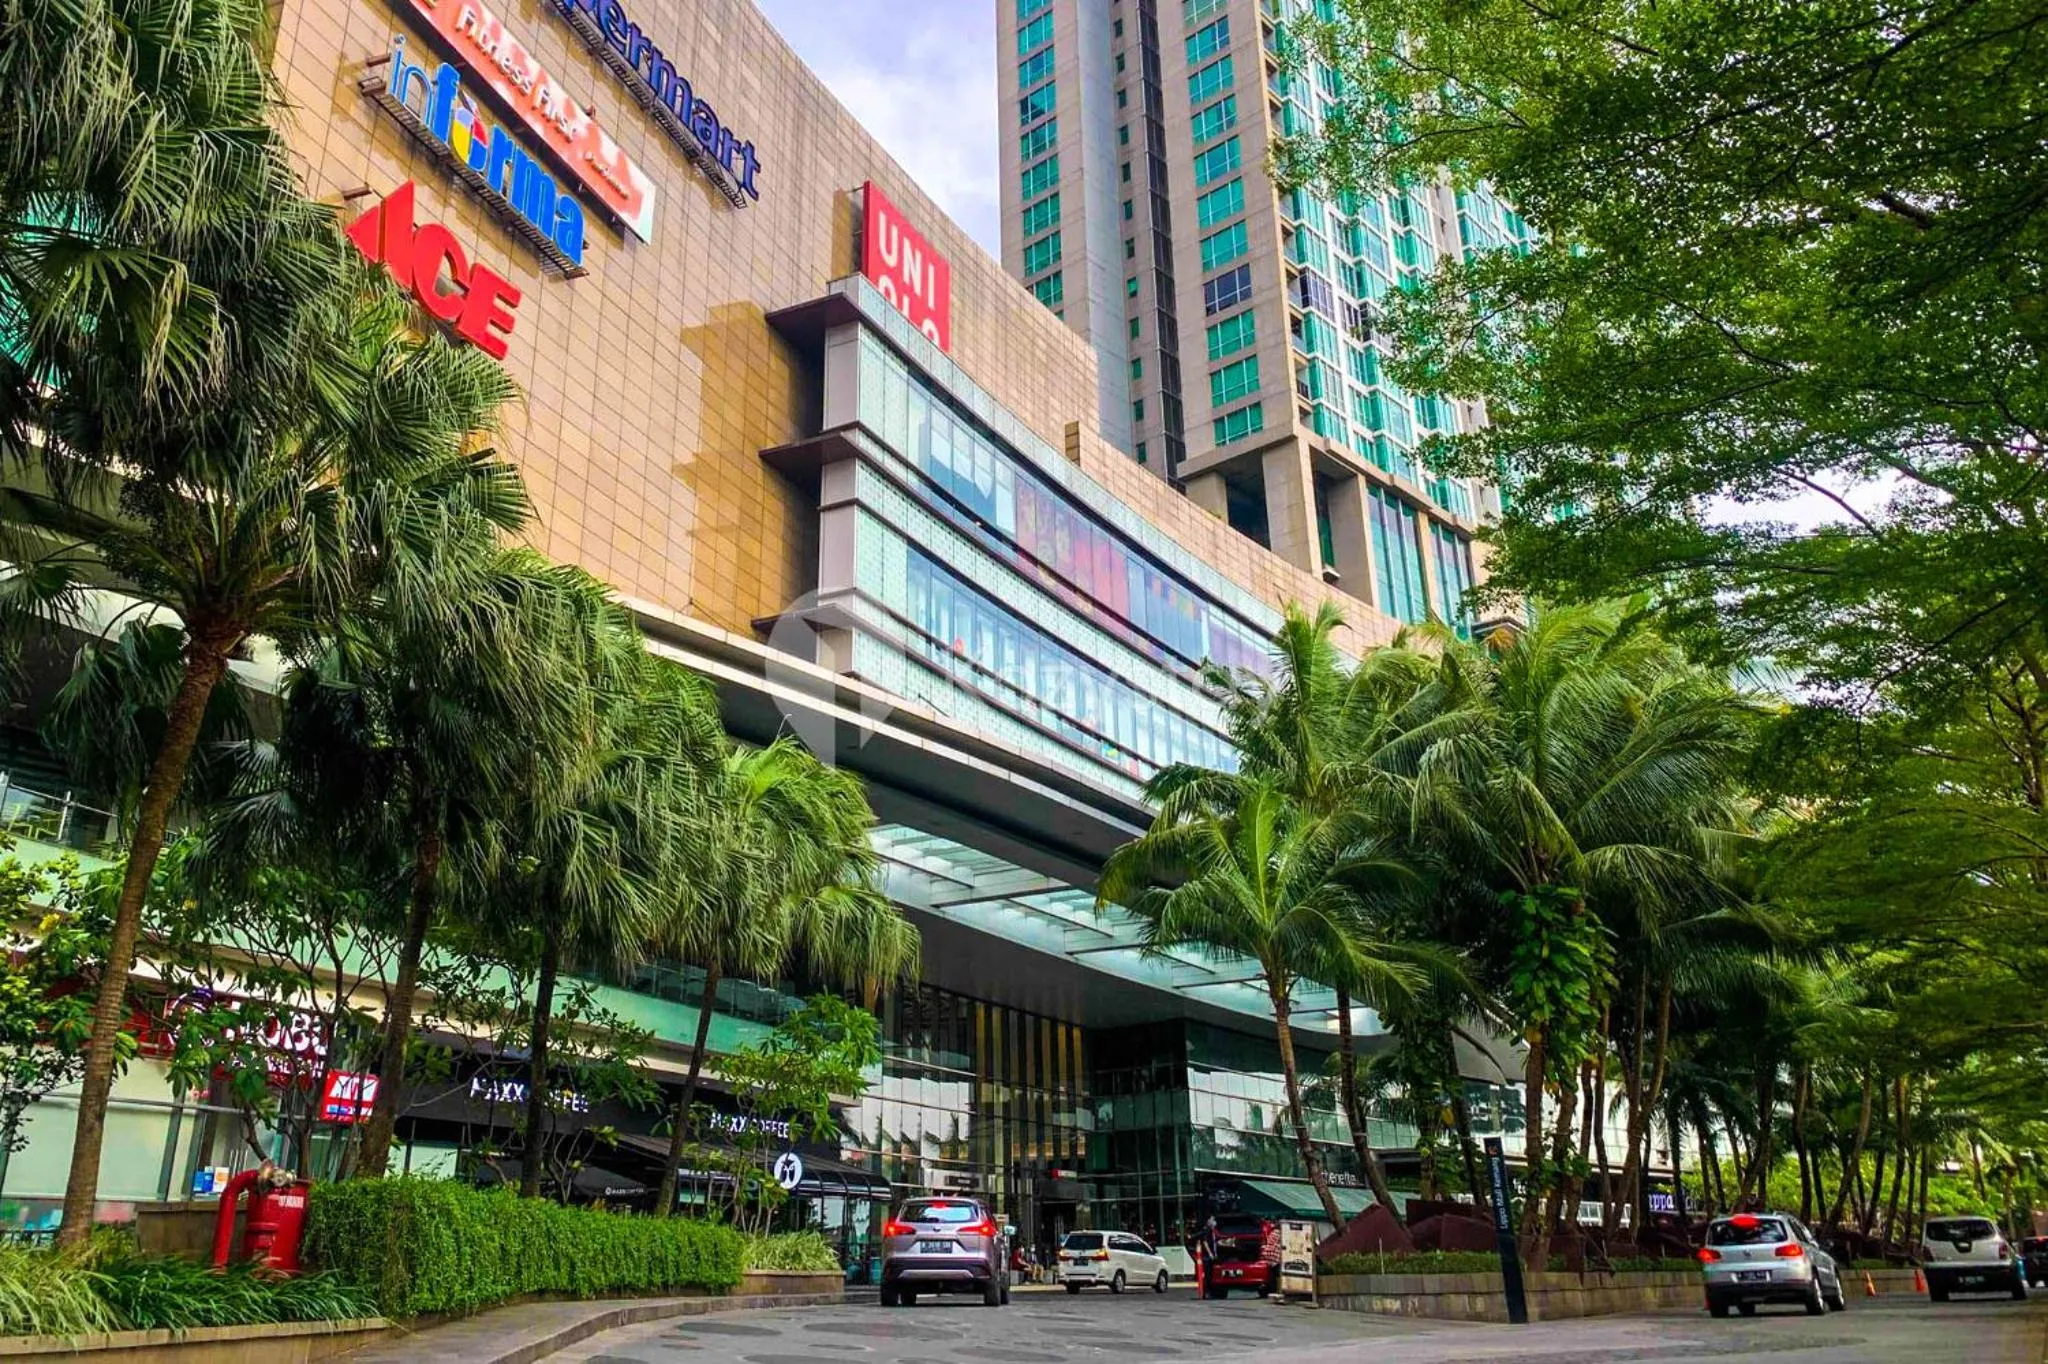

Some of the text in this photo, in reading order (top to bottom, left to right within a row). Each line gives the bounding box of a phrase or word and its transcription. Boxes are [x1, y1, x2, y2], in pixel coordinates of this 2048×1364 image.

[389, 33, 585, 267] informa
[559, 0, 761, 201] ermart
[344, 176, 521, 361] ACE
[879, 211, 935, 311] UNI
